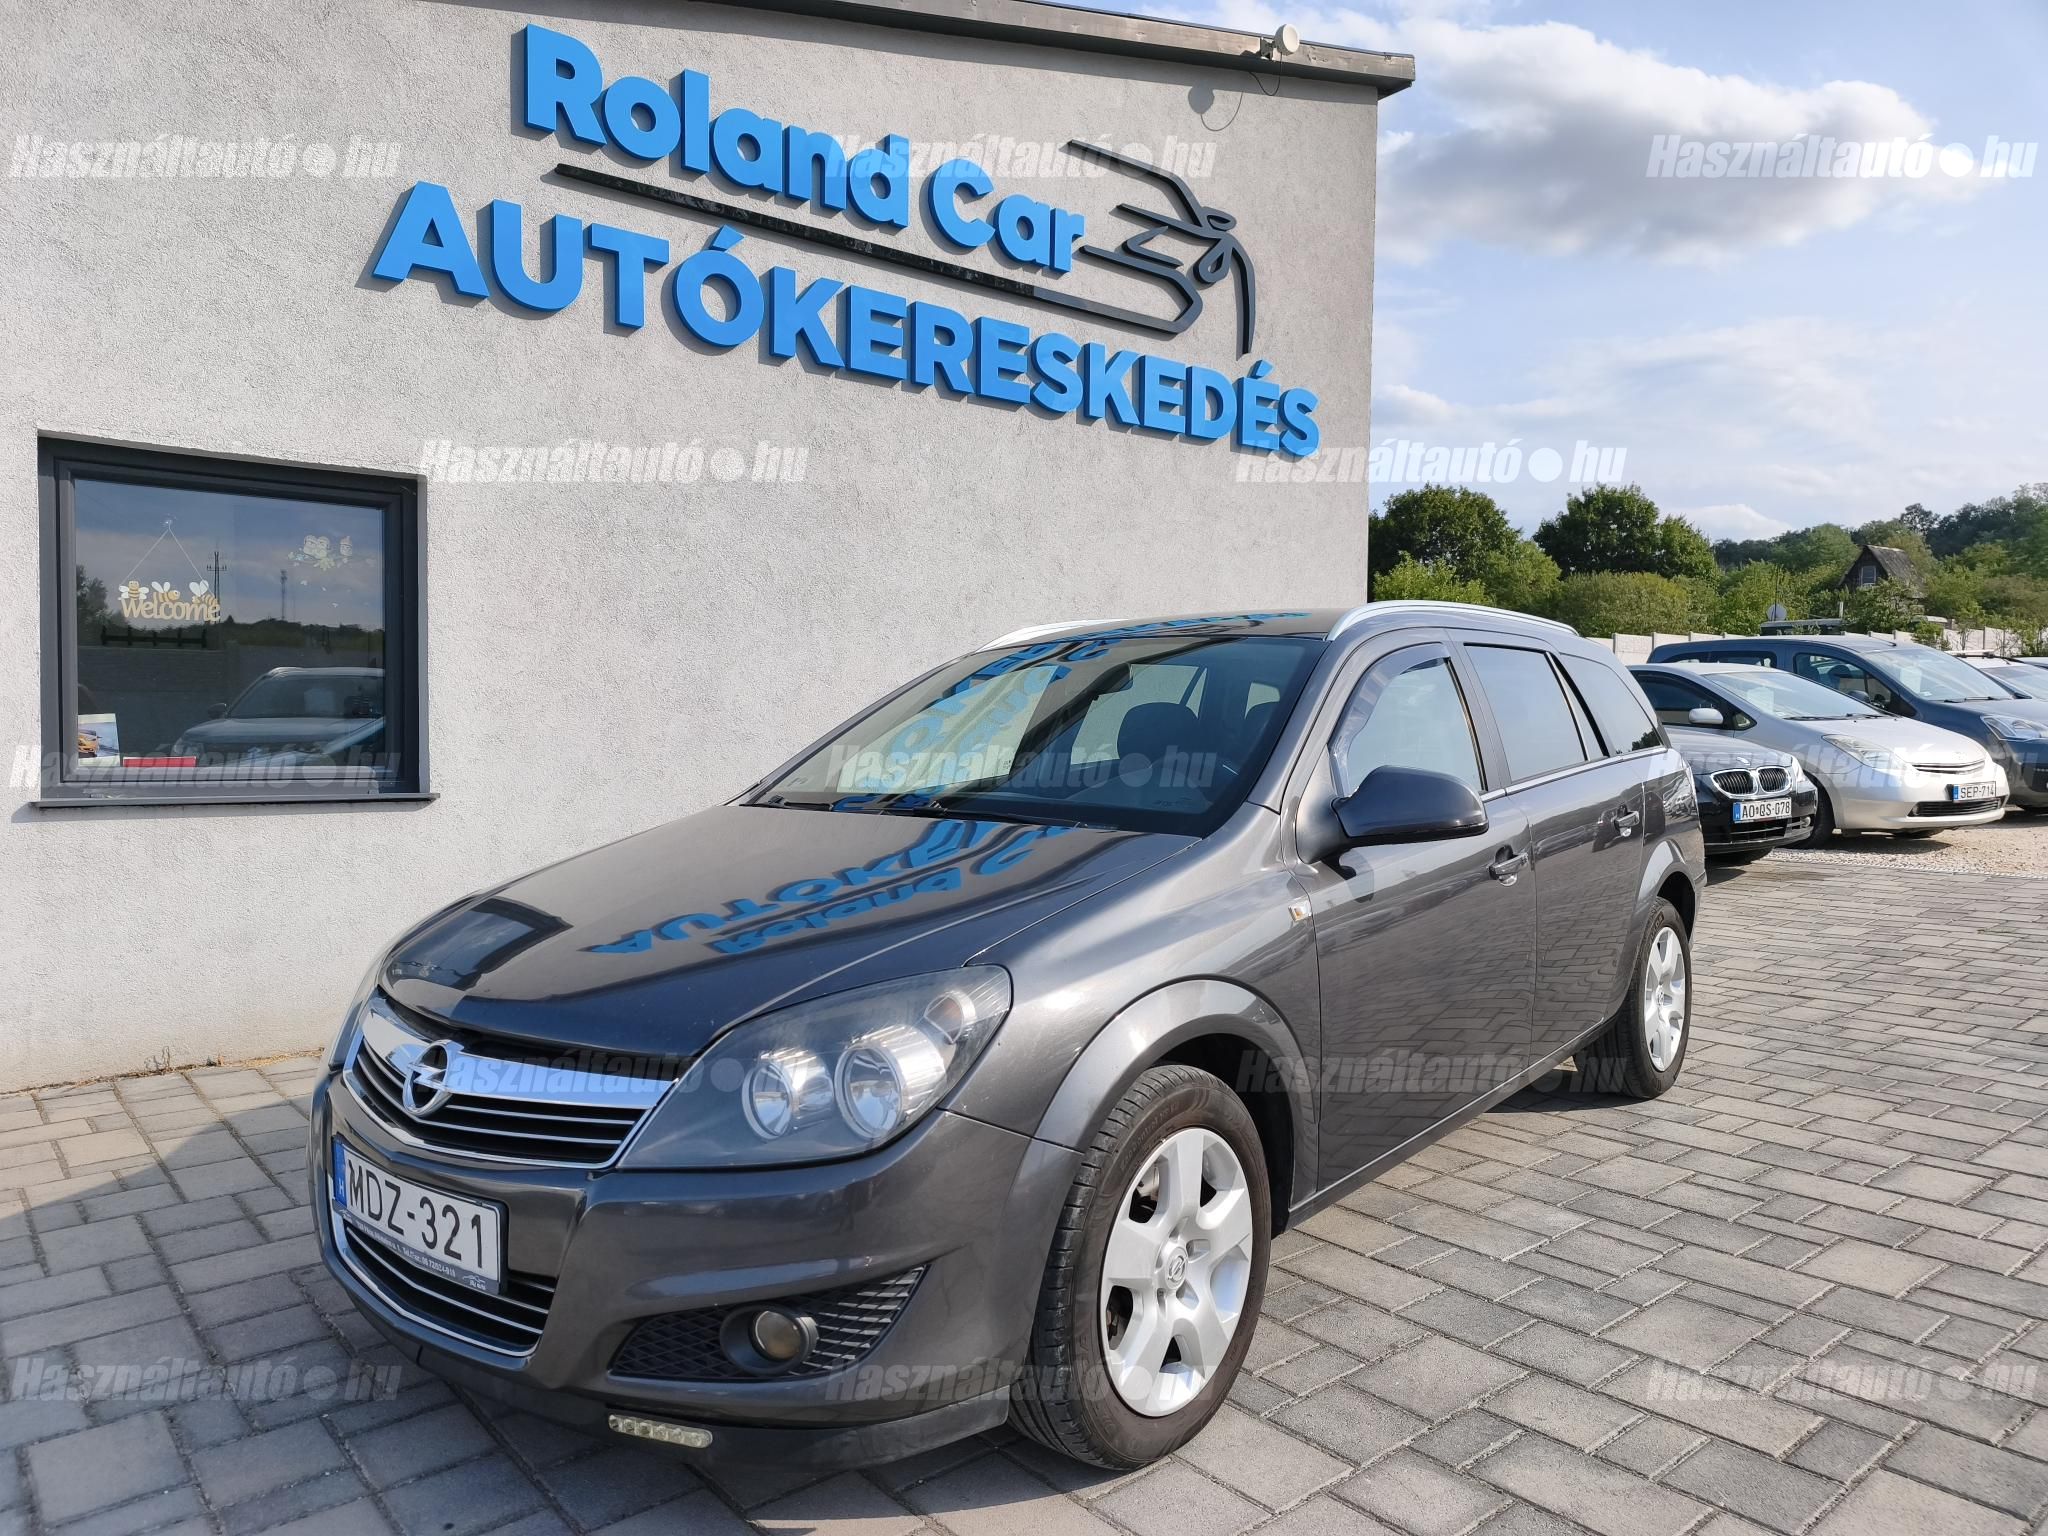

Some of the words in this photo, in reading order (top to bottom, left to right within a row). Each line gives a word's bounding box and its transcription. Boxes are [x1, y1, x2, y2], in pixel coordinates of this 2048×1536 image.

[525, 23, 910, 229] Roland
[928, 158, 1084, 273] Car
[372, 181, 1320, 457] AUTÓKERESKEDÉS
[1960, 784, 1995, 798] SEP-714
[347, 1158, 483, 1268] MDZ-321
